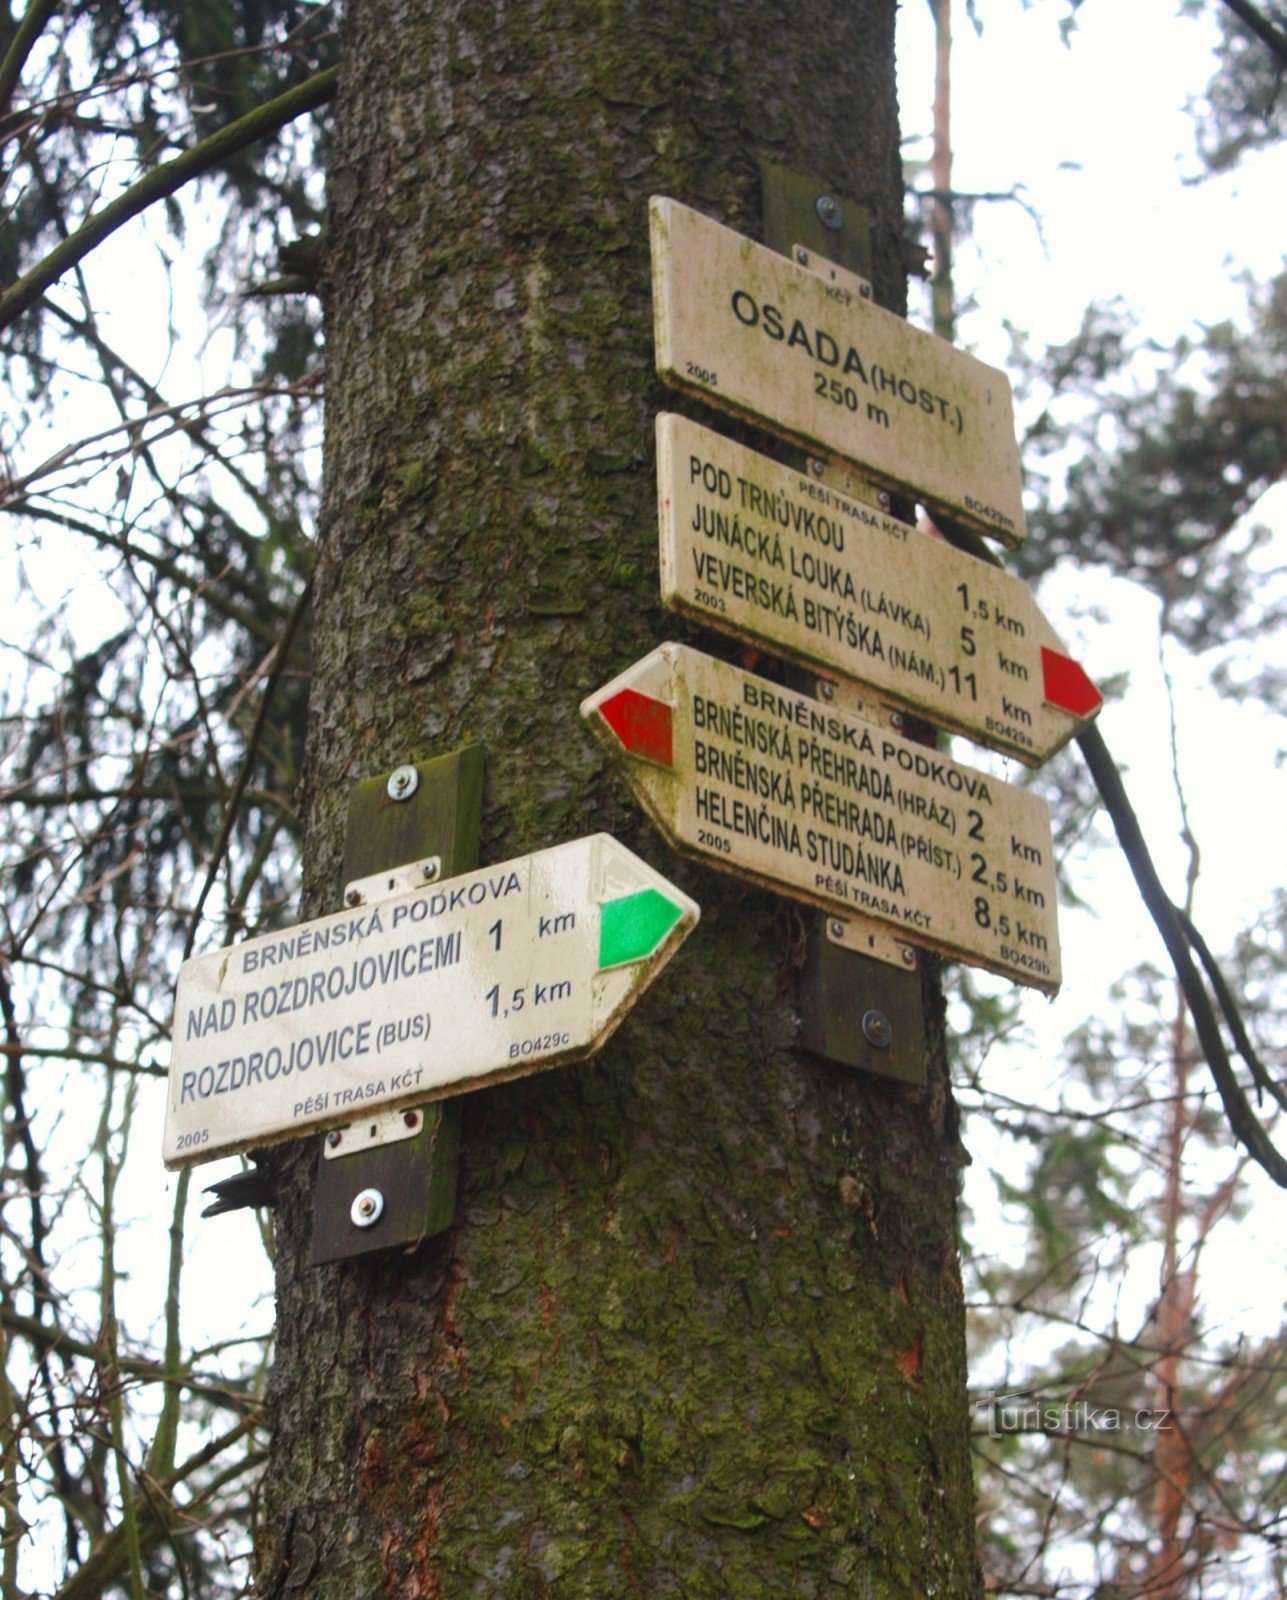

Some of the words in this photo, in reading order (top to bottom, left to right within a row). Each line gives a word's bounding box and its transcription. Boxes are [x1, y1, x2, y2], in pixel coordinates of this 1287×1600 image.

[686, 362, 718, 386] 2005
[731, 290, 868, 384] OSADA
[870, 364, 963, 434] (HOST.)
[814, 372, 858, 412] 250
[867, 403, 890, 428] m
[690, 455, 731, 500] POD
[737, 477, 844, 553] TRNŮVKOU
[957, 583, 989, 621] 1,5
[995, 606, 1025, 637] km
[799, 479, 830, 506] PĚŠÍ
[835, 497, 878, 527] TRASA
[882, 518, 909, 542] KČT
[692, 503, 785, 570] JUNÁCKÁ
[791, 547, 856, 603] LOUKA
[861, 588, 930, 642] (LÁVKA)
[961, 626, 976, 656] 5
[999, 651, 1028, 681] km
[693, 548, 798, 623] VEVERSKÁ
[804, 598, 884, 661] BITÝŠKA
[889, 645, 945, 693] (NÁM.)
[949, 665, 977, 701] 11
[1002, 696, 1032, 726] km
[694, 588, 726, 613] 2003
[694, 695, 793, 765] BRNĚNSKÁ
[798, 734, 895, 806] PŘEHRADA
[897, 788, 956, 836] (HRÁZ)
[968, 809, 985, 842] 2
[1011, 834, 1042, 866] km
[743, 682, 875, 756] BRNĚNSKÁ
[882, 741, 992, 806] PODKOVA
[695, 739, 796, 810] BRNĚNSKÁ
[801, 780, 898, 851] PŘEHRADA
[901, 832, 961, 881] (PŘÍST.)
[971, 852, 1008, 893] 2,5
[1014, 878, 1045, 909] km
[695, 785, 802, 857] HELENČINA
[807, 829, 905, 896] STUDÁNKA
[974, 896, 1011, 937] 8,5
[1017, 922, 1048, 952] km
[698, 829, 731, 854] 2005
[242, 907, 383, 974] BRNĚNSKÁ
[392, 872, 522, 929] PODKOVA
[815, 874, 847, 898] PĚŠÍ
[852, 889, 900, 918] TRASA
[904, 909, 932, 929] KČT
[186, 997, 237, 1041] NAD
[242, 931, 461, 1026] ROZDROJOVICEMI
[489, 919, 503, 952] 1
[538, 912, 575, 938] km
[1000, 945, 1050, 976] BO429b
[180, 1020, 372, 1105] ROZDROJOVICE
[376, 1012, 432, 1054] (BUS)
[485, 984, 525, 1020] 1,5
[534, 980, 571, 1005] km
[293, 1091, 329, 1118] PĚŠÍ
[334, 1079, 386, 1105] TRASA
[391, 1066, 424, 1090] KČT
[508, 1031, 570, 1059] BO429c
[176, 1128, 210, 1150] 2005
